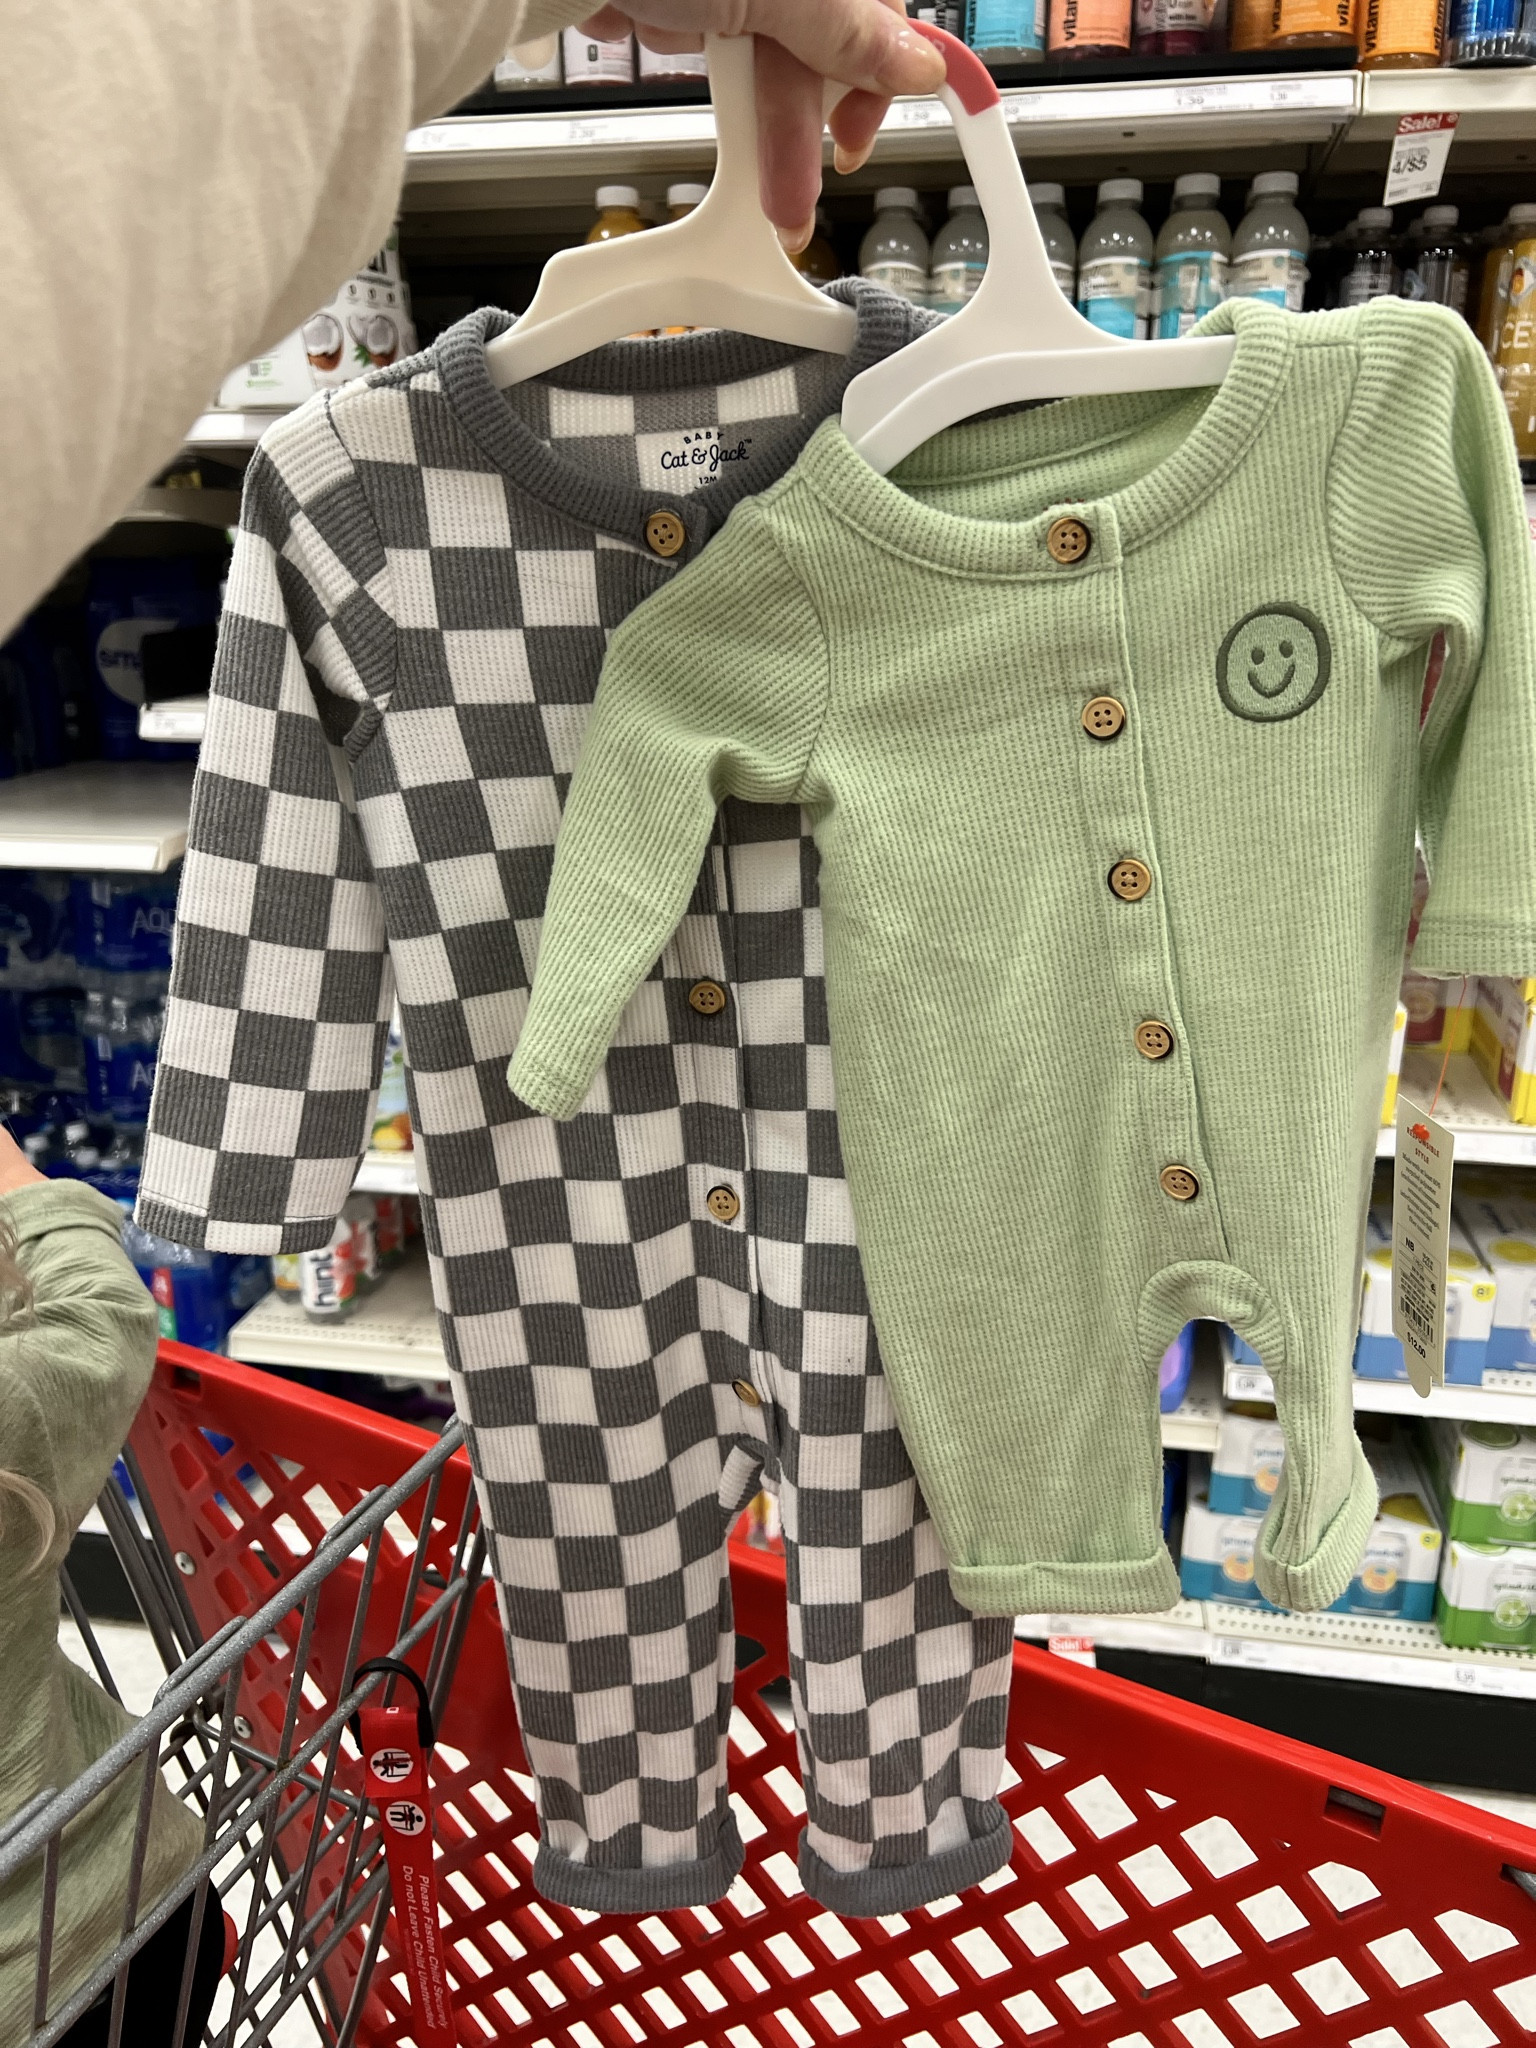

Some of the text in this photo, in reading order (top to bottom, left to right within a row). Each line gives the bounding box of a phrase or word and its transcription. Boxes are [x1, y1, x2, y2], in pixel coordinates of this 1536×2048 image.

[1398, 113, 1443, 132] Sale!
[683, 431, 725, 445] BABY
[661, 451, 690, 470] Cat
[691, 447, 708, 465] &
[699, 476, 718, 485] 12M
[1415, 1147, 1430, 1165] STYLE
[1406, 1237, 1415, 1251] NB
[310, 1253, 337, 1307] hint
[1407, 1332, 1426, 1358] $12.00
[402, 1865, 414, 1881] Do
[405, 1886, 417, 1904] not
[408, 1904, 420, 1938] Leave
[413, 1940, 427, 1969] Child
[419, 1874, 449, 2030] Please Fasten Child Securely
[418, 1970, 437, 2030] Unattended
